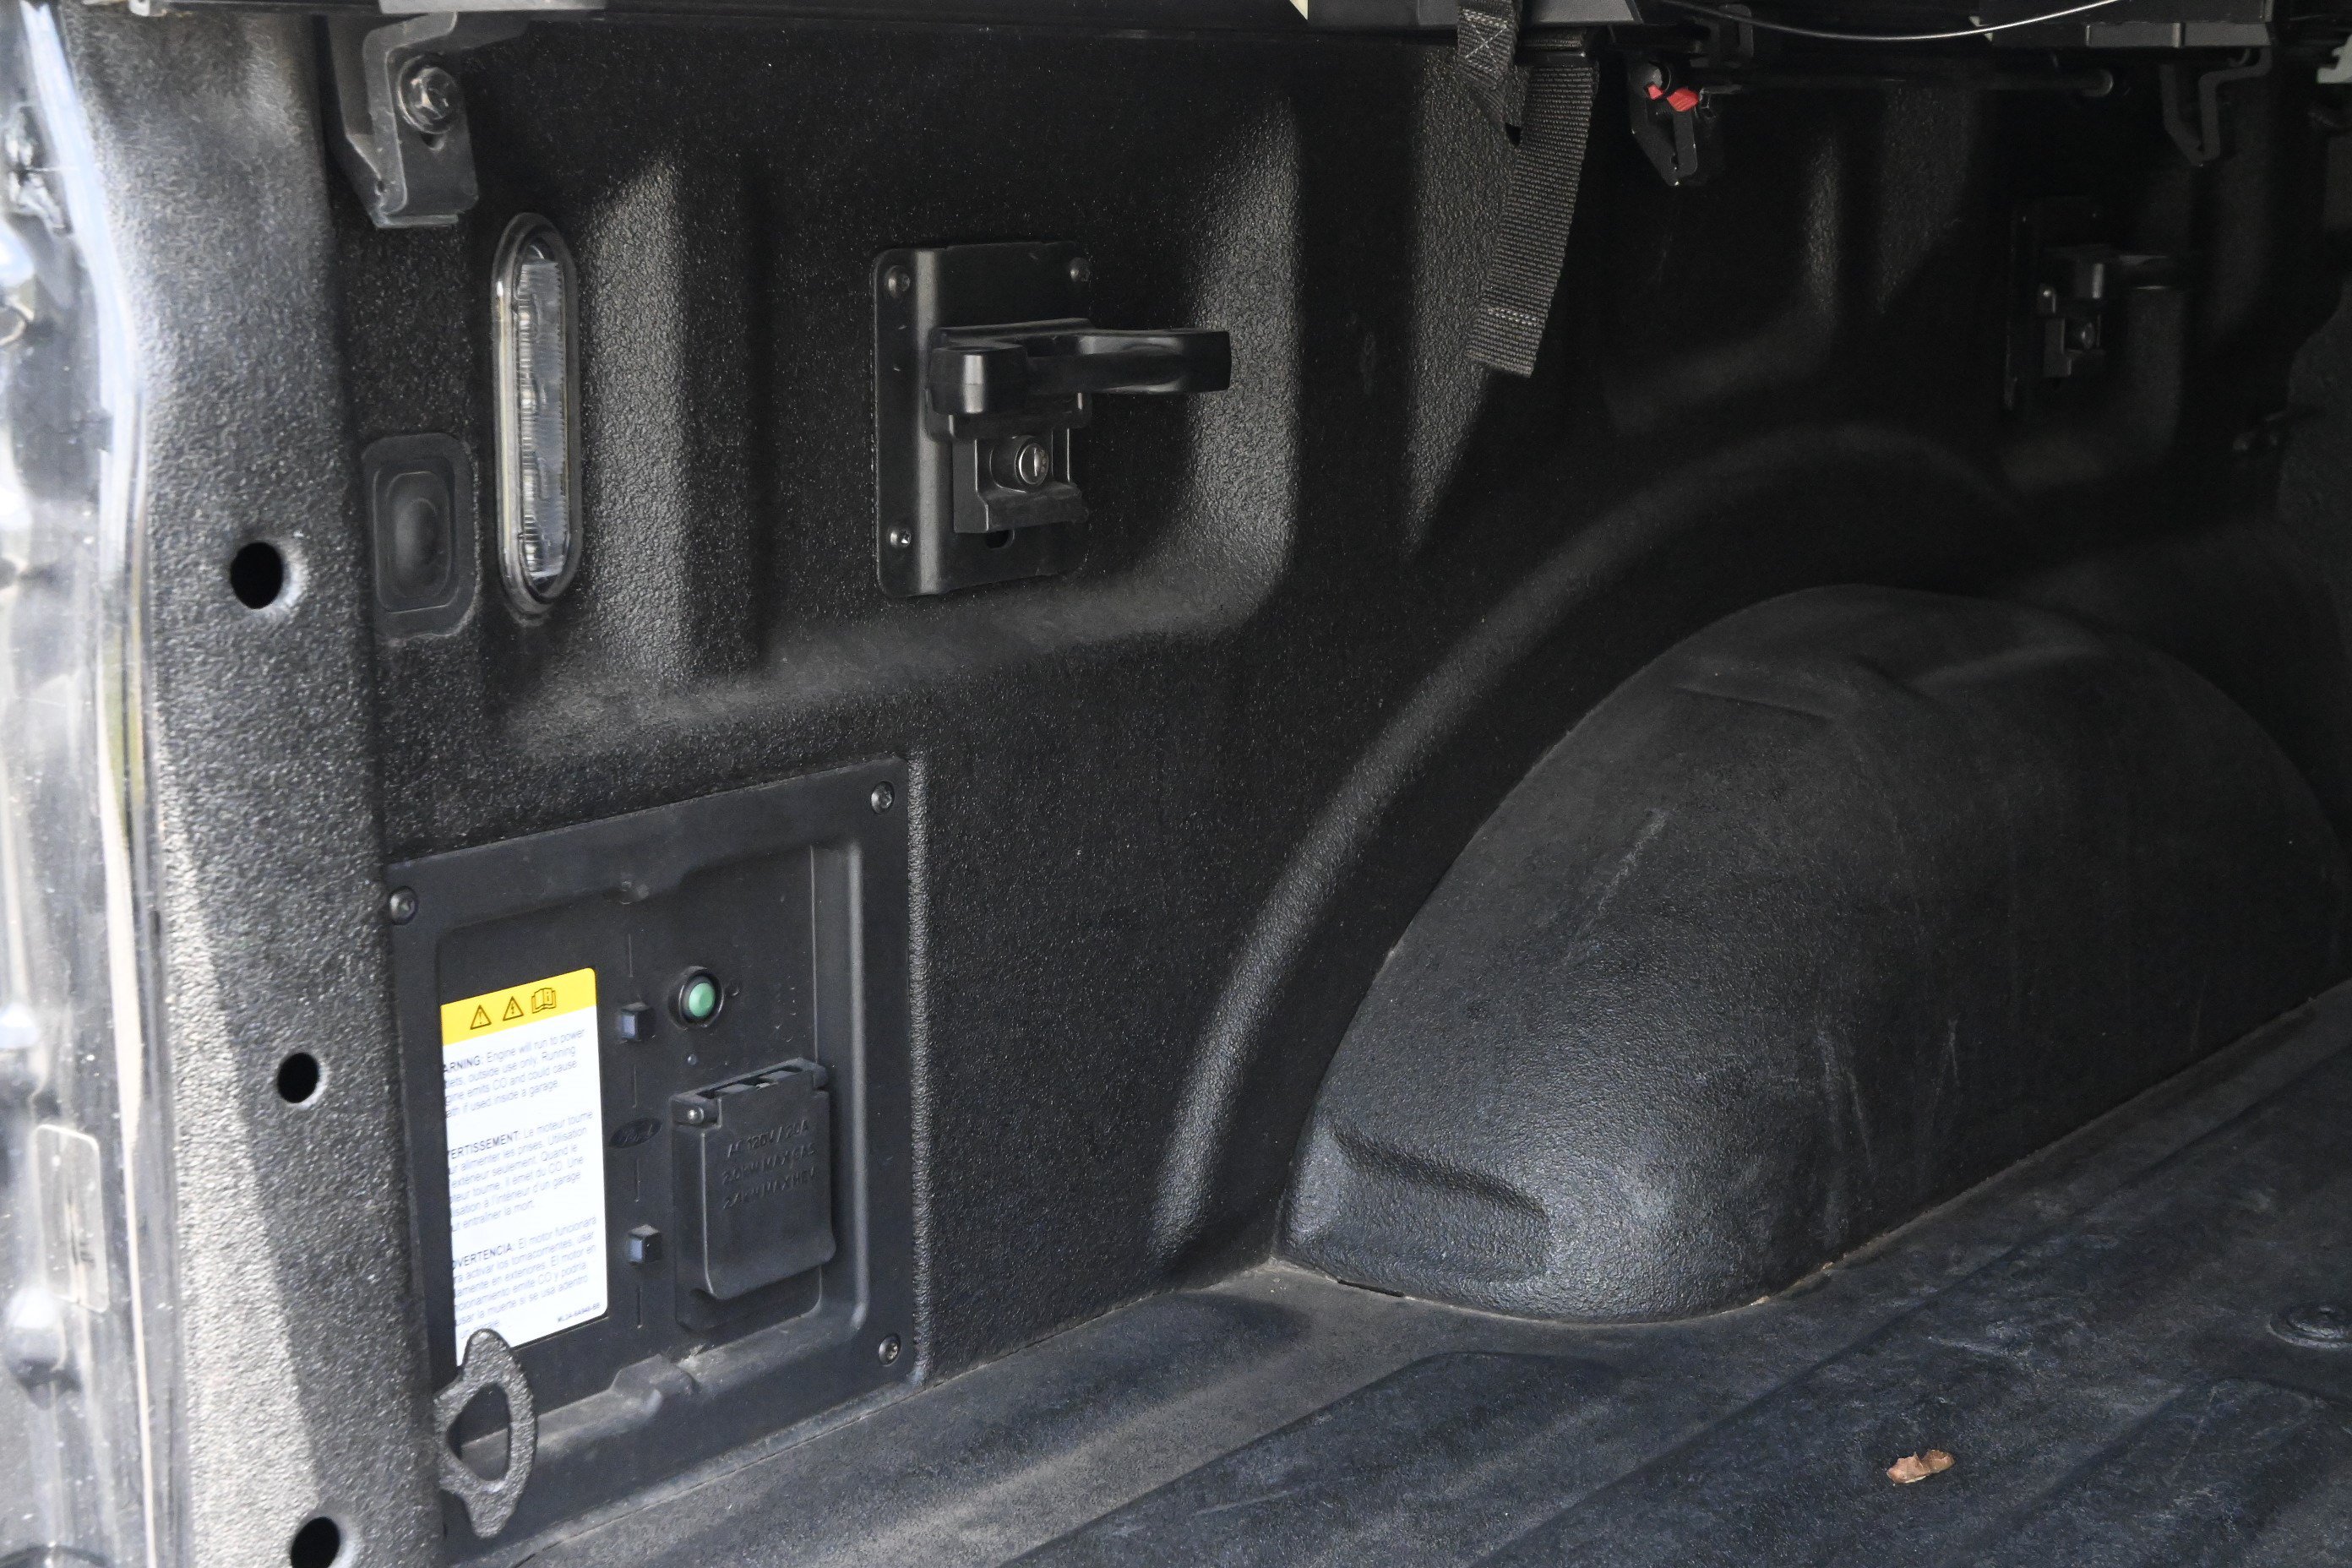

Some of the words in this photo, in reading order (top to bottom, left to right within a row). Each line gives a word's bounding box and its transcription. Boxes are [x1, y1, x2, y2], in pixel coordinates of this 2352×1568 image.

[487, 1048, 516, 1063] Engine
[518, 1042, 532, 1054] will
[533, 1039, 547, 1049] run
[549, 1037, 558, 1045] to
[560, 1030, 585, 1043] power
[466, 1083, 490, 1097] emits
[492, 1077, 507, 1090] CO
[509, 1072, 525, 1086] and
[527, 1067, 550, 1081] could
[553, 1059, 578, 1074] cause
[468, 1067, 499, 1082] outside
[502, 1062, 517, 1073] use
[541, 1046, 575, 1061] Running
[471, 1096, 491, 1111] used
[493, 1090, 519, 1104] inside
[521, 1088, 526, 1097] a
[523, 1129, 534, 1139] Le
[536, 1119, 565, 1133] moteur
[567, 1111, 593, 1125] tourne
[460, 1152, 501, 1171] alimenter
[503, 1148, 515, 1158] les
[547, 1127, 587, 1146] Utilisation
[540, 1146, 569, 1162] Quand
[570, 1143, 577, 1152] le
[535, 1168, 547, 1178] du
[567, 1156, 584, 1168] Une
[553, 1171, 581, 1190] garage
[504, 1206, 511, 1216] la
[518, 1237, 526, 1249] El
[528, 1231, 553, 1244] motor
[465, 1264, 494, 1280] activar
[497, 1260, 509, 1270] los
[576, 1231, 594, 1244] usar
[492, 1276, 502, 1286] en
[550, 1255, 558, 1266] El
[561, 1248, 585, 1261] motor
[585, 1244, 596, 1255] en
[512, 1278, 536, 1293] emite
[537, 1271, 552, 1285] CO
[553, 1272, 558, 1282] y
[476, 1309, 485, 1319] la
[487, 1299, 517, 1315] muerte
[519, 1297, 526, 1305] si
[528, 1292, 539, 1302] se
[541, 1286, 556, 1298] usa
[557, 1275, 588, 1292] adentro
